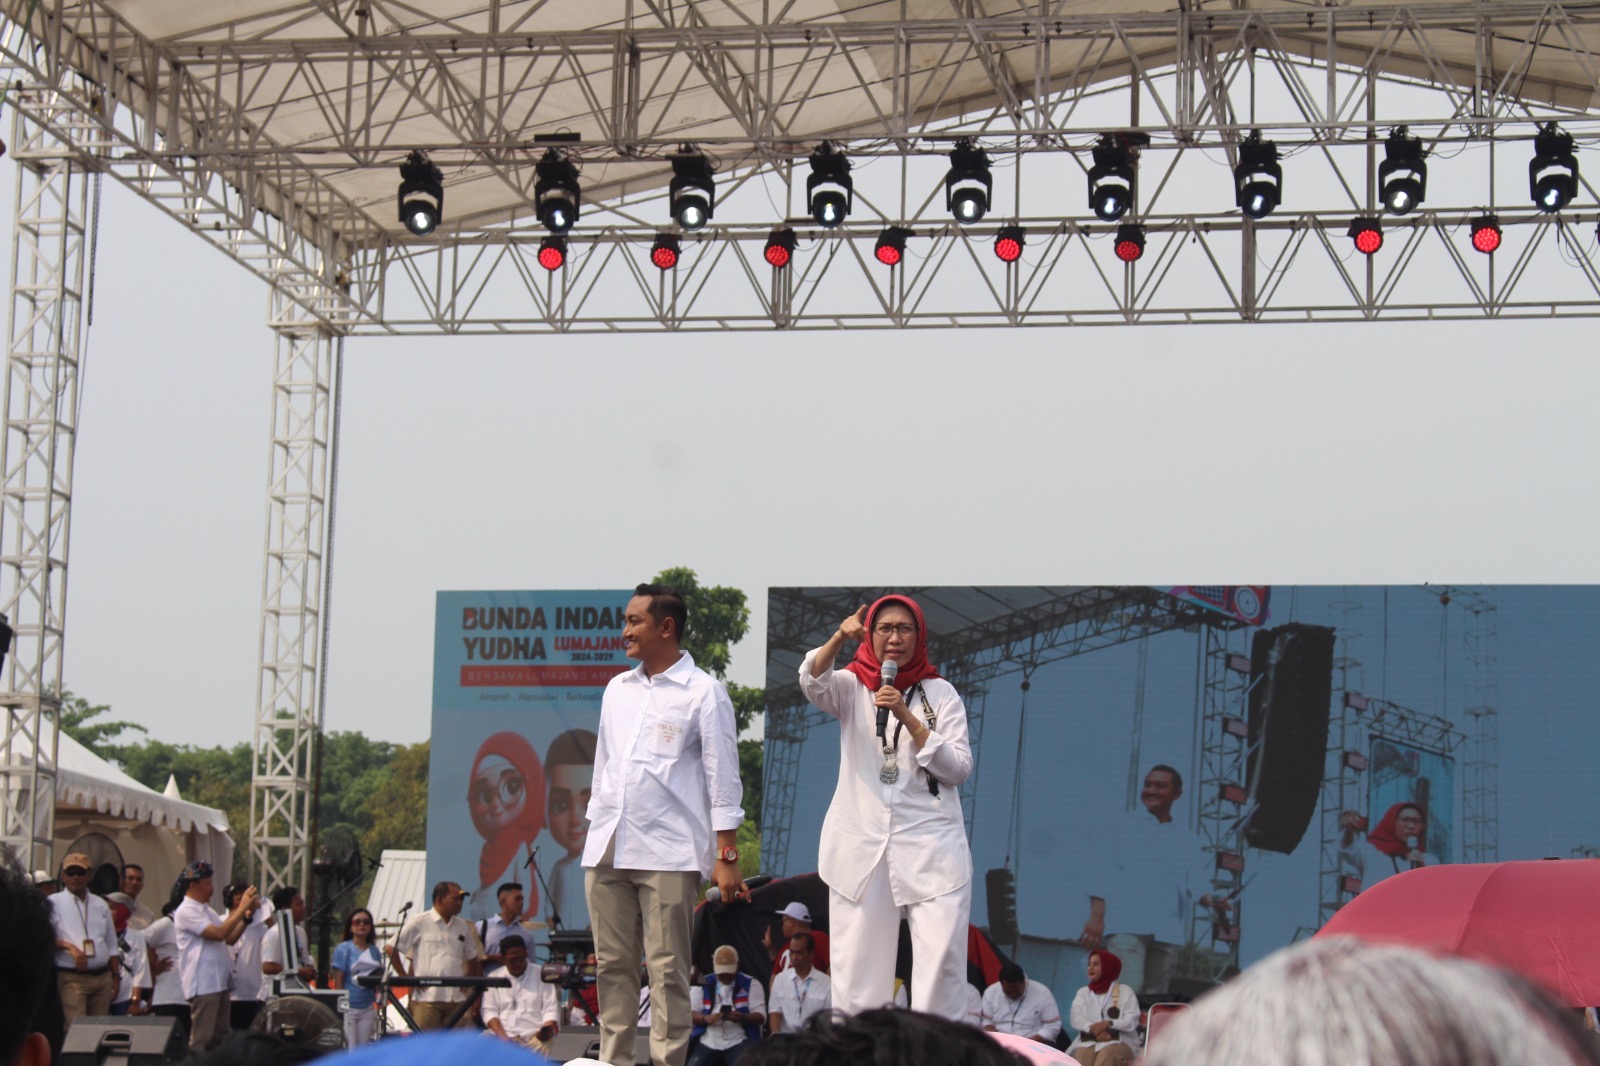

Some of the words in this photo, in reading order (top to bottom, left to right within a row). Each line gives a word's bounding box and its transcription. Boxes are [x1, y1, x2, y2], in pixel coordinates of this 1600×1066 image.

[463, 607, 547, 630] BUNDA
[463, 637, 547, 660] YUDHA
[571, 653, 613, 661] 2024-2029
[468, 671, 522, 681] BERSAMA
[526, 671, 588, 681] LUMAJANG
[592, 671, 617, 681] AMA
[657, 723, 683, 733] PRADA
